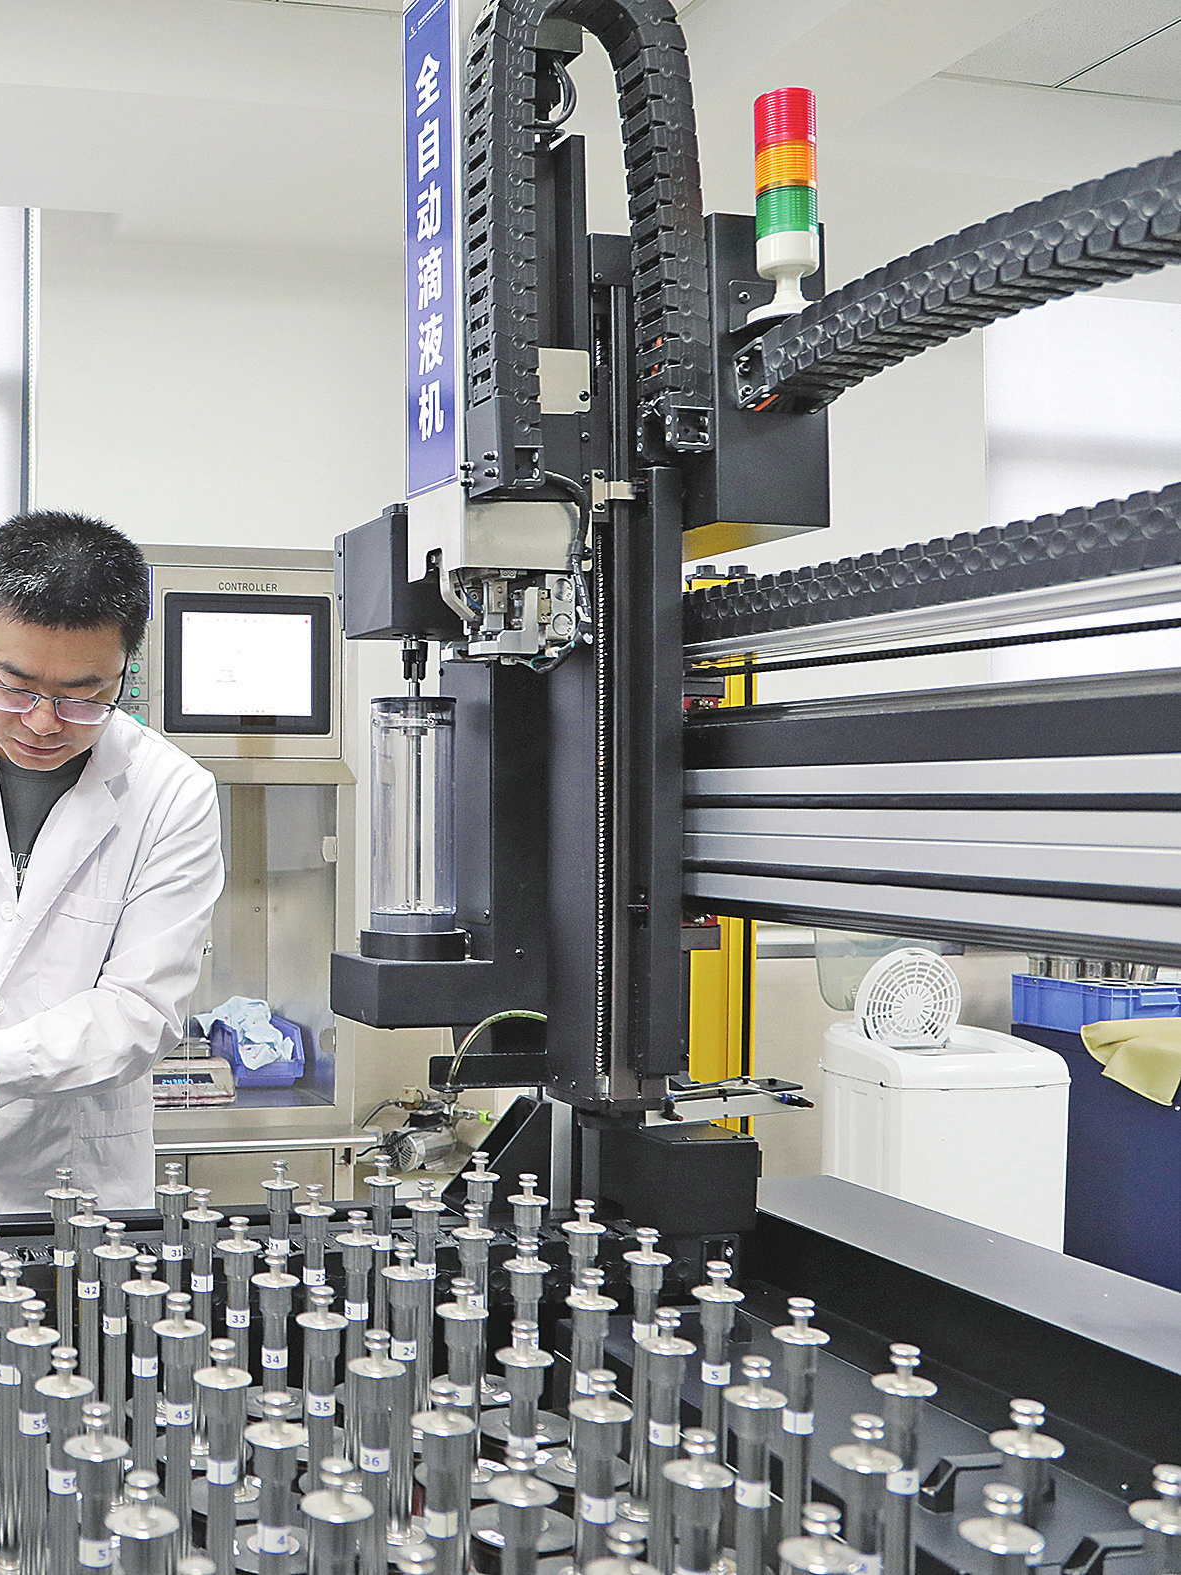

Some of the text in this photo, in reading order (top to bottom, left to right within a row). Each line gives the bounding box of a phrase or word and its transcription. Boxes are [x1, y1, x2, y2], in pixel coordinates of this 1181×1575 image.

[414, 53, 445, 443] 全自动滴液机
[218, 581, 278, 592] CONTROLLER
[171, 1249, 182, 1258] 31
[84, 1286, 98, 1295] 42
[232, 1315, 246, 1324] 33
[265, 1355, 280, 1364] 34
[711, 1371, 719, 1381] 5
[314, 1401, 330, 1411] 35
[175, 1410, 191, 1420] 45
[363, 1454, 380, 1467] 36
